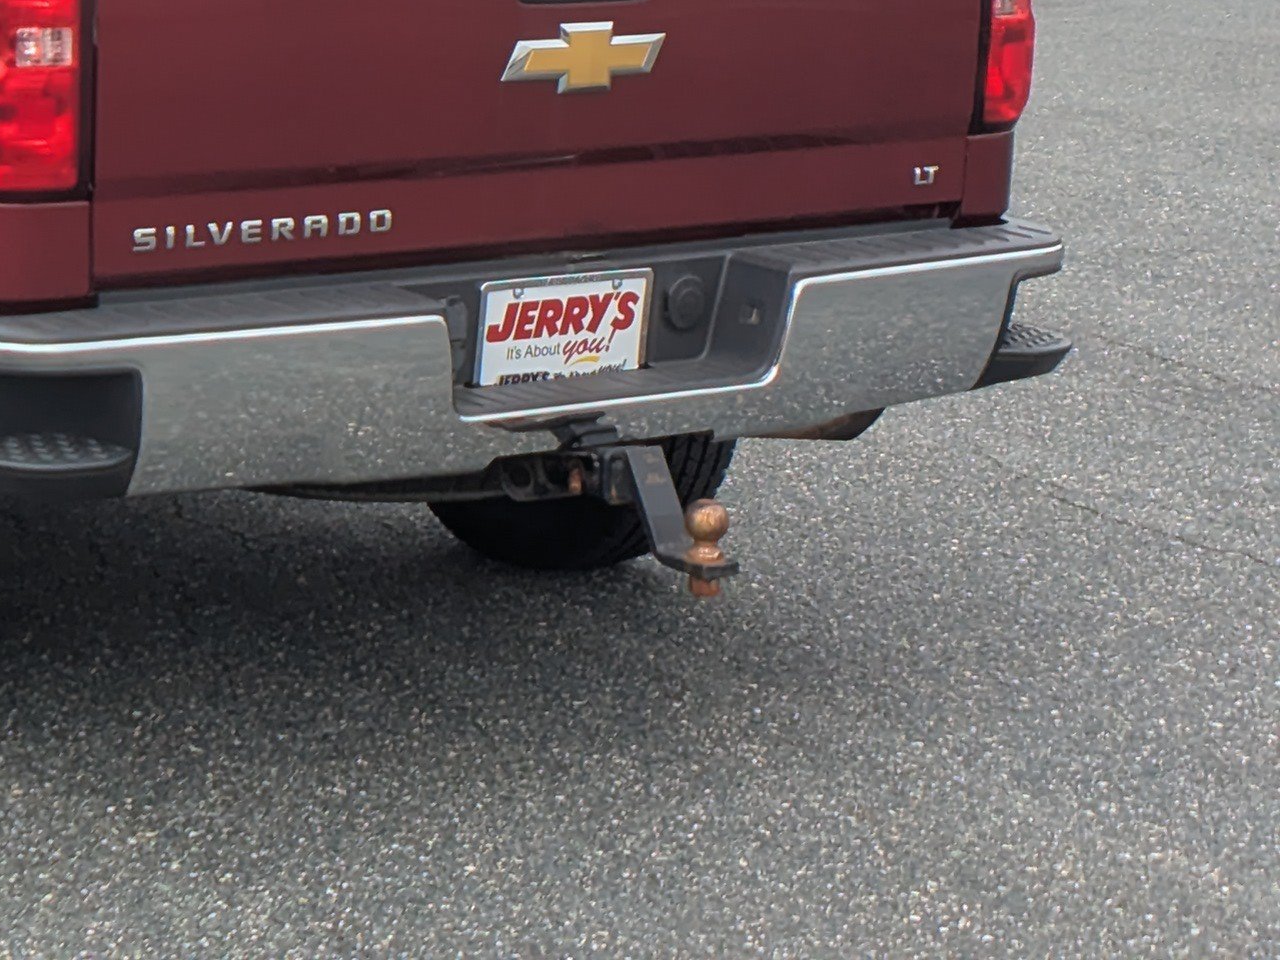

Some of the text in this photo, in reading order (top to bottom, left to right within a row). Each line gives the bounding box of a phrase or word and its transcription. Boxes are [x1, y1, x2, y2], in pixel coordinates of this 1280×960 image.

[914, 165, 939, 185] LT
[133, 209, 392, 252] SILVERADO
[486, 291, 639, 343] JERRY'S
[506, 332, 615, 365] It's About you!
